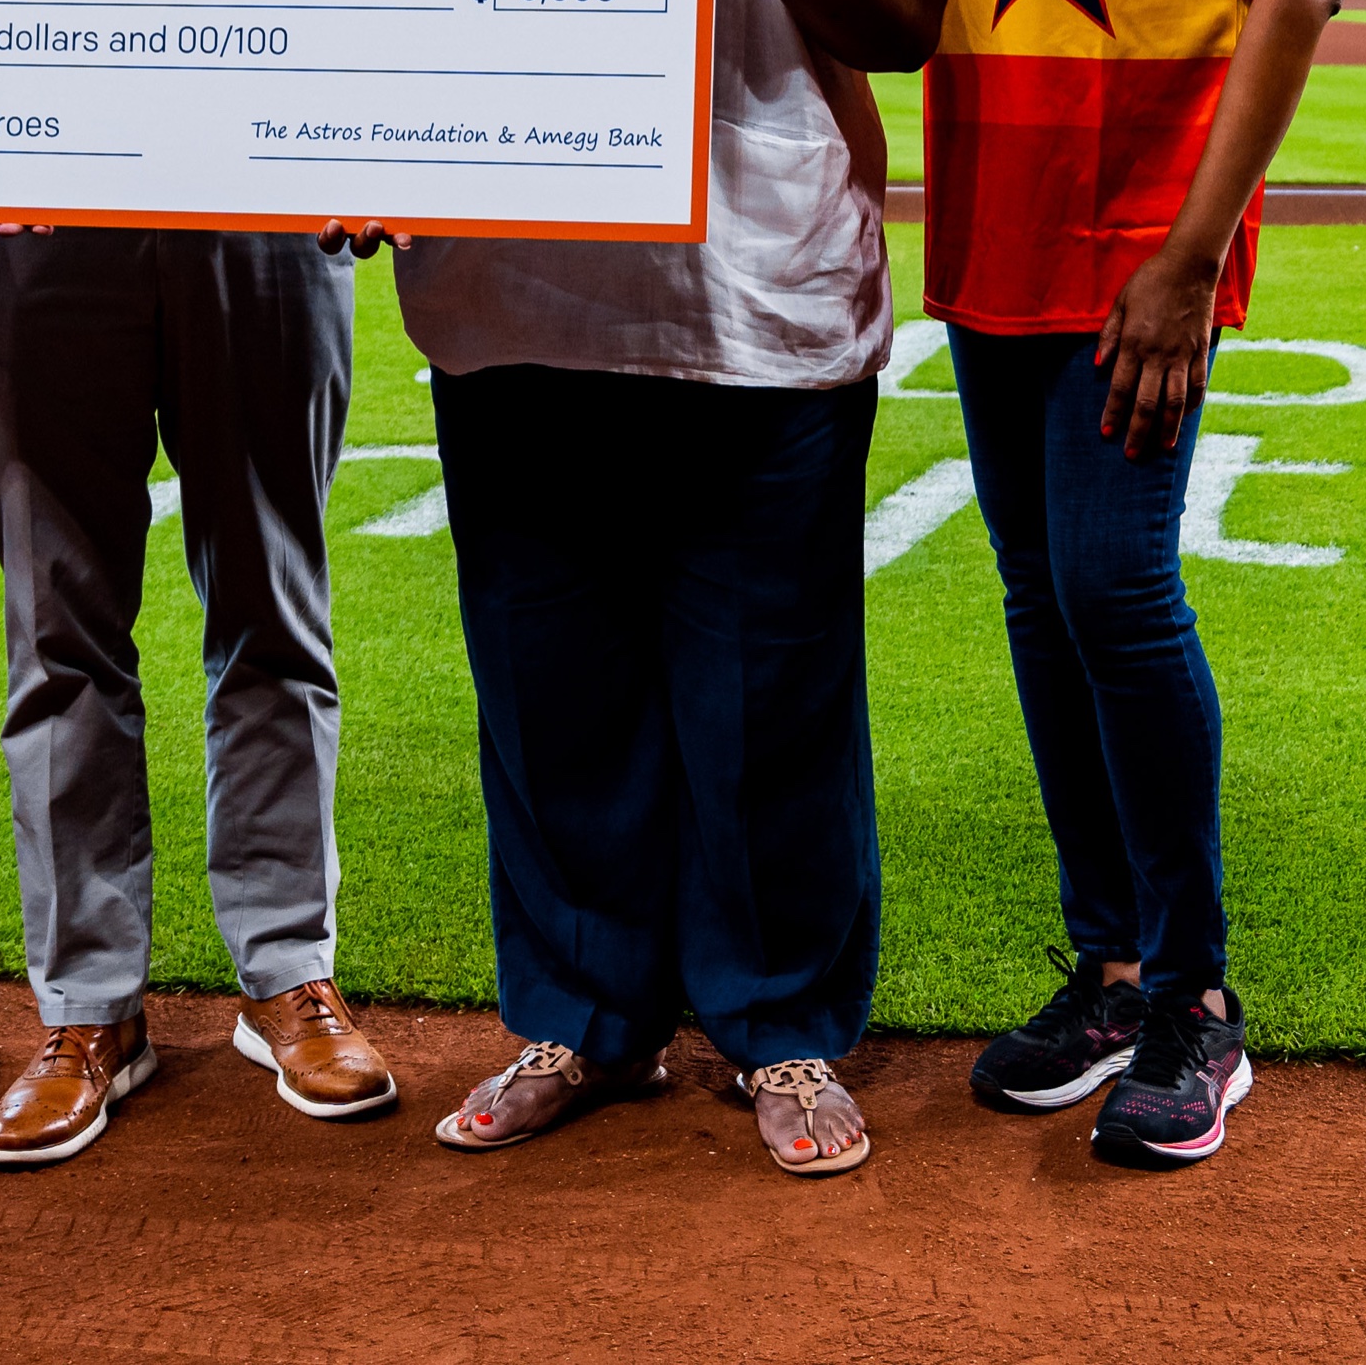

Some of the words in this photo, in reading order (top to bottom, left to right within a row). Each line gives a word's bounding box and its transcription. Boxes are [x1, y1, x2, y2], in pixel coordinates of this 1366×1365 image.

[110, 26, 166, 53] and
[178, 26, 288, 57] 00/100
[251, 121, 287, 139] The
[296, 122, 362, 141] Astros
[371, 122, 488, 144] Foundation
[498, 127, 516, 144] &
[525, 127, 599, 151] Amegy
[608, 128, 663, 148] Bank
